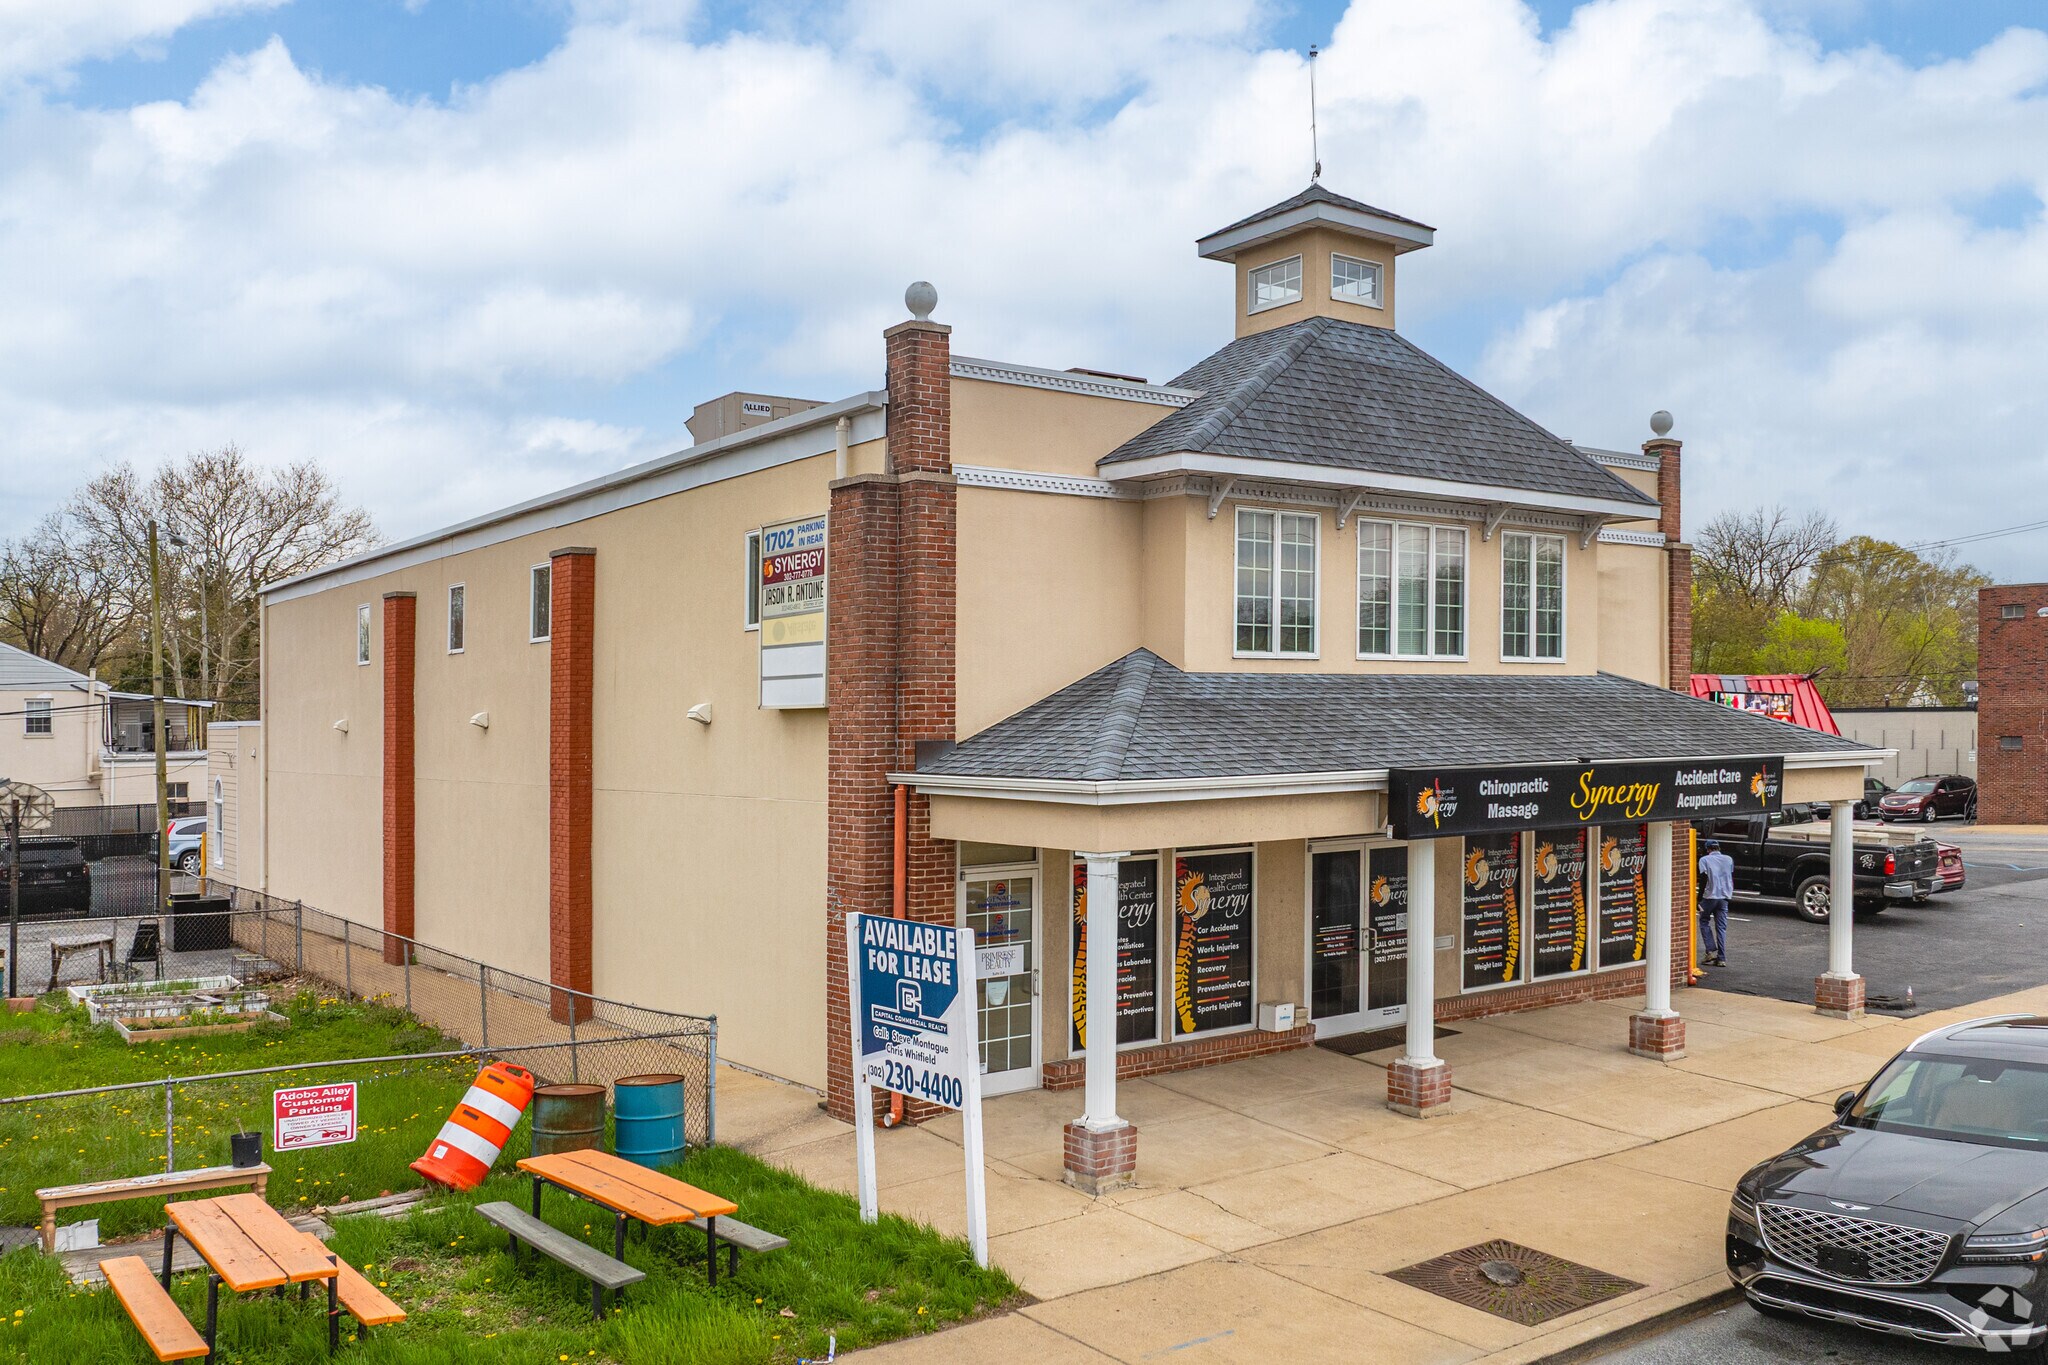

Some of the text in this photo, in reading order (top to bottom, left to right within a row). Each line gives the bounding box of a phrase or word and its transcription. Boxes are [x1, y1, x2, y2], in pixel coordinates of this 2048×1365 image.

[744, 403, 770, 412] ALLIED
[797, 520, 825, 534] PARKING
[765, 528, 794, 552] 1702
[798, 534, 823, 546] IN REAR
[774, 550, 823, 573] SYNERGY
[765, 587, 785, 606] JASON
[796, 580, 824, 601] ANTOINE
[1675, 770, 1741, 786] Accident Care
[1479, 777, 1549, 797] Chiropractic
[1570, 768, 1661, 821] Synergy
[1676, 790, 1737, 808] Acupuncture
[1488, 802, 1539, 820] Massage
[1209, 868, 1242, 882] Integrated
[1118, 877, 1146, 892] egrated
[1226, 883, 1248, 891] Center
[1129, 892, 1153, 900] Center
[1184, 887, 1250, 922] Synergy
[1118, 902, 1155, 928] ergy
[1198, 924, 1239, 934] Car Accidents
[864, 918, 955, 959] AVAILABLE
[1197, 943, 1239, 954] Work Injuries
[981, 950, 1016, 962] PRIMROSE
[1124, 958, 1152, 967] Laborales
[868, 949, 951, 986] FOR LEASE
[985, 959, 1011, 970] BEAUTY
[1197, 964, 1226, 973] Recovery
[1197, 982, 1236, 993] Preventative
[1123, 990, 1153, 1000] Preventivo
[1123, 1006, 1154, 1015] Deportivas
[1197, 1001, 1242, 1014] Sports Injuries
[875, 1011, 947, 1032] CAPITAL COMMERCIAL REALTY
[874, 1026, 948, 1054] Call: Steve Montague
[886, 1043, 936, 1065] Chris Whitfield
[868, 1059, 962, 1108] (302) 230-4400
[279, 1087, 351, 1101] Adobo Alley
[282, 1096, 349, 1107] Customer
[289, 1105, 342, 1116] Parking
